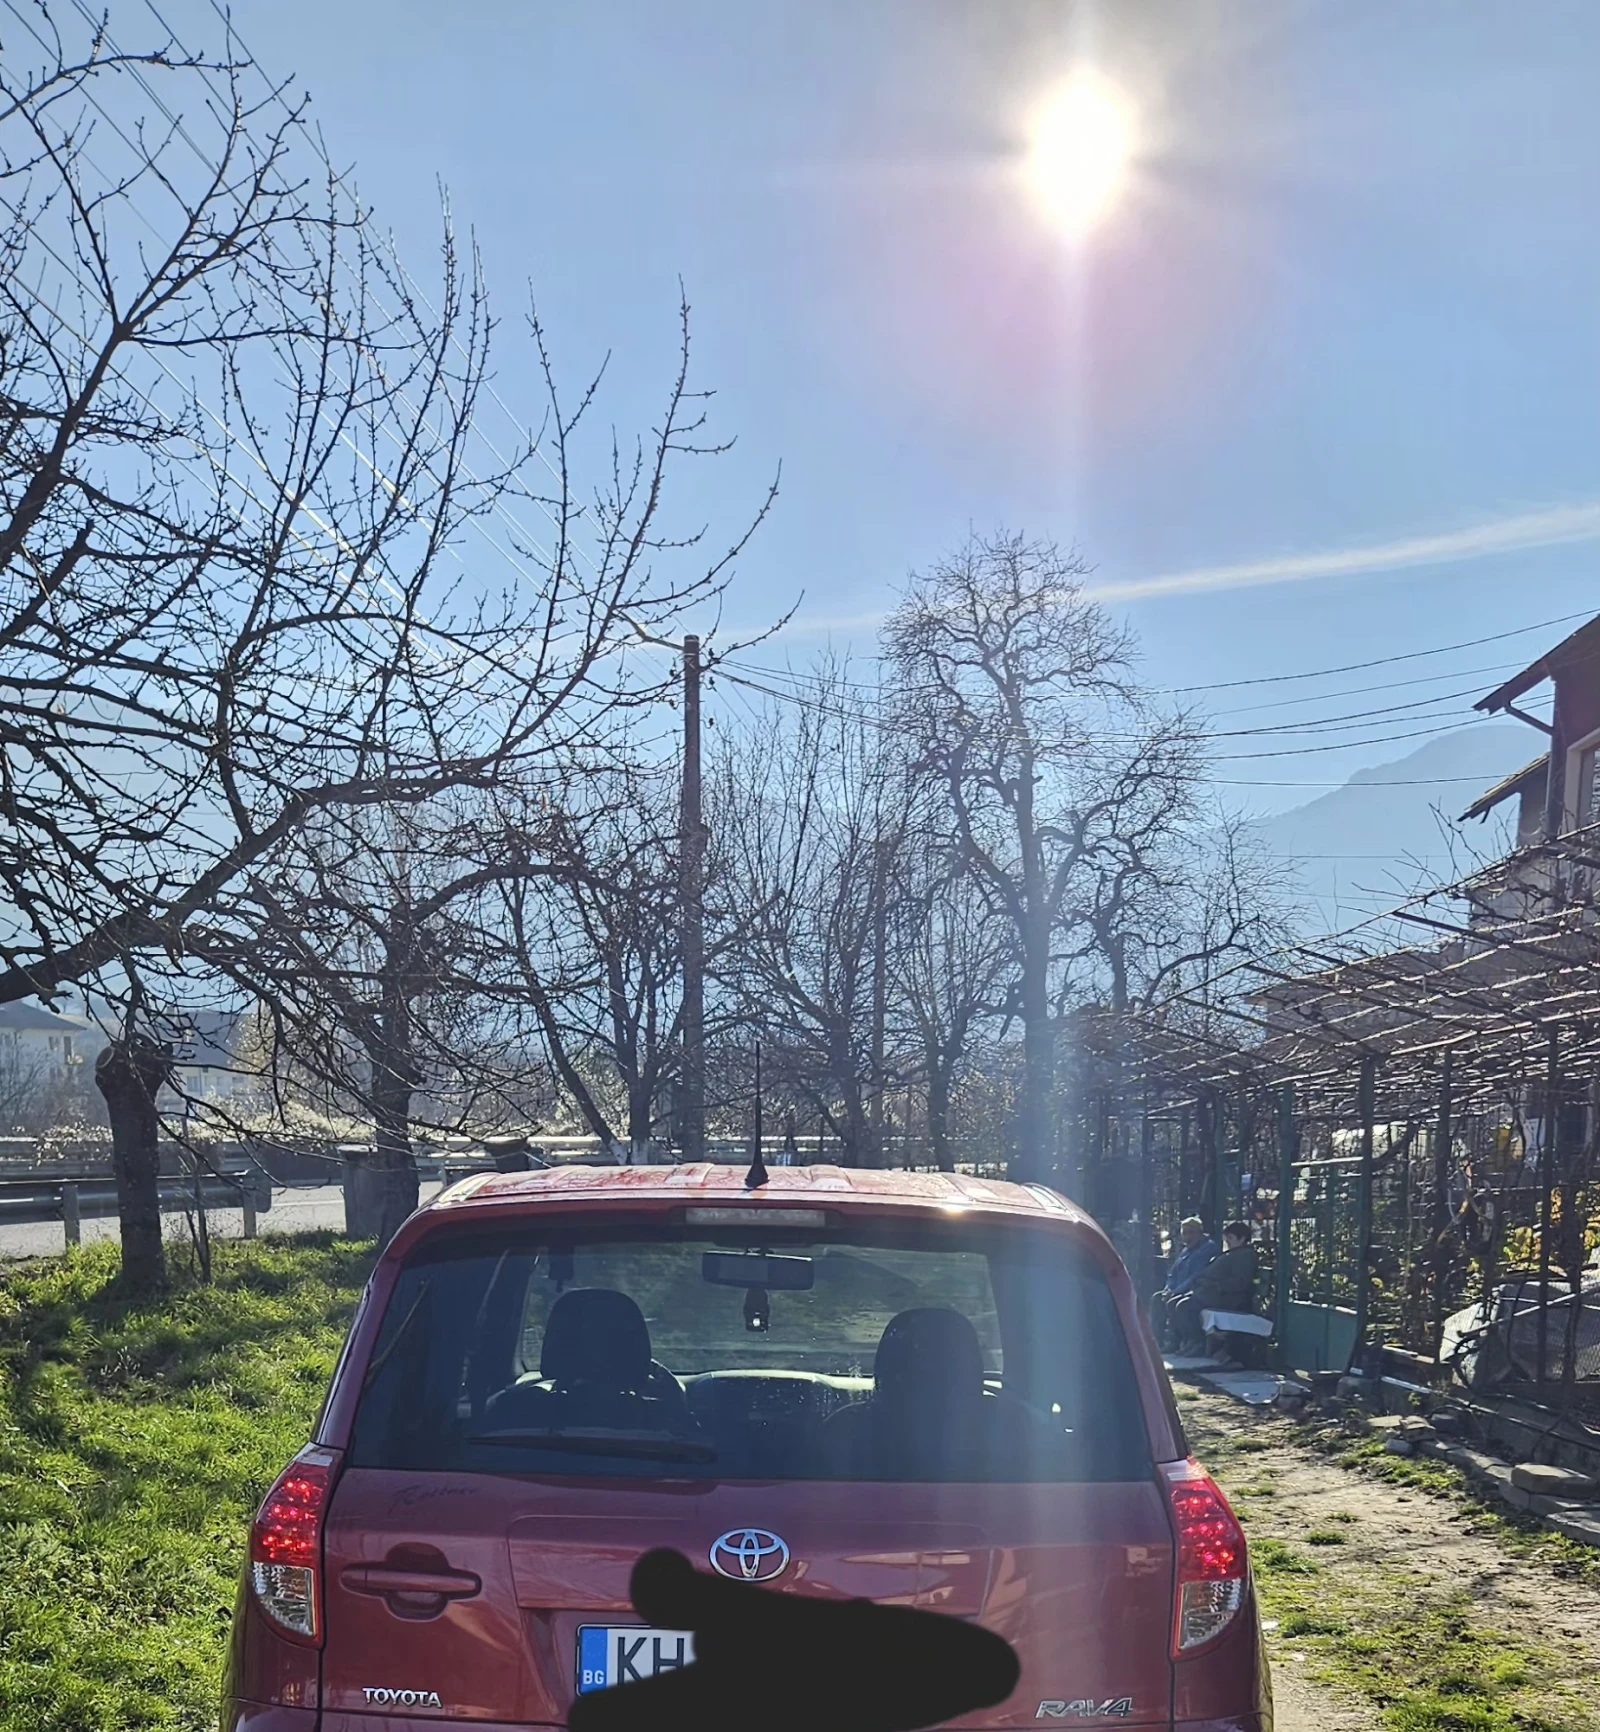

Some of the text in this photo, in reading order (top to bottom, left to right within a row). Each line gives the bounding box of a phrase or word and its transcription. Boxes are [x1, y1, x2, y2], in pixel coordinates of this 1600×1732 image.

[582, 1669, 605, 1685] BG
[362, 1687, 442, 1708] TOYOTA
[1035, 1697, 1133, 1719] RAV4
